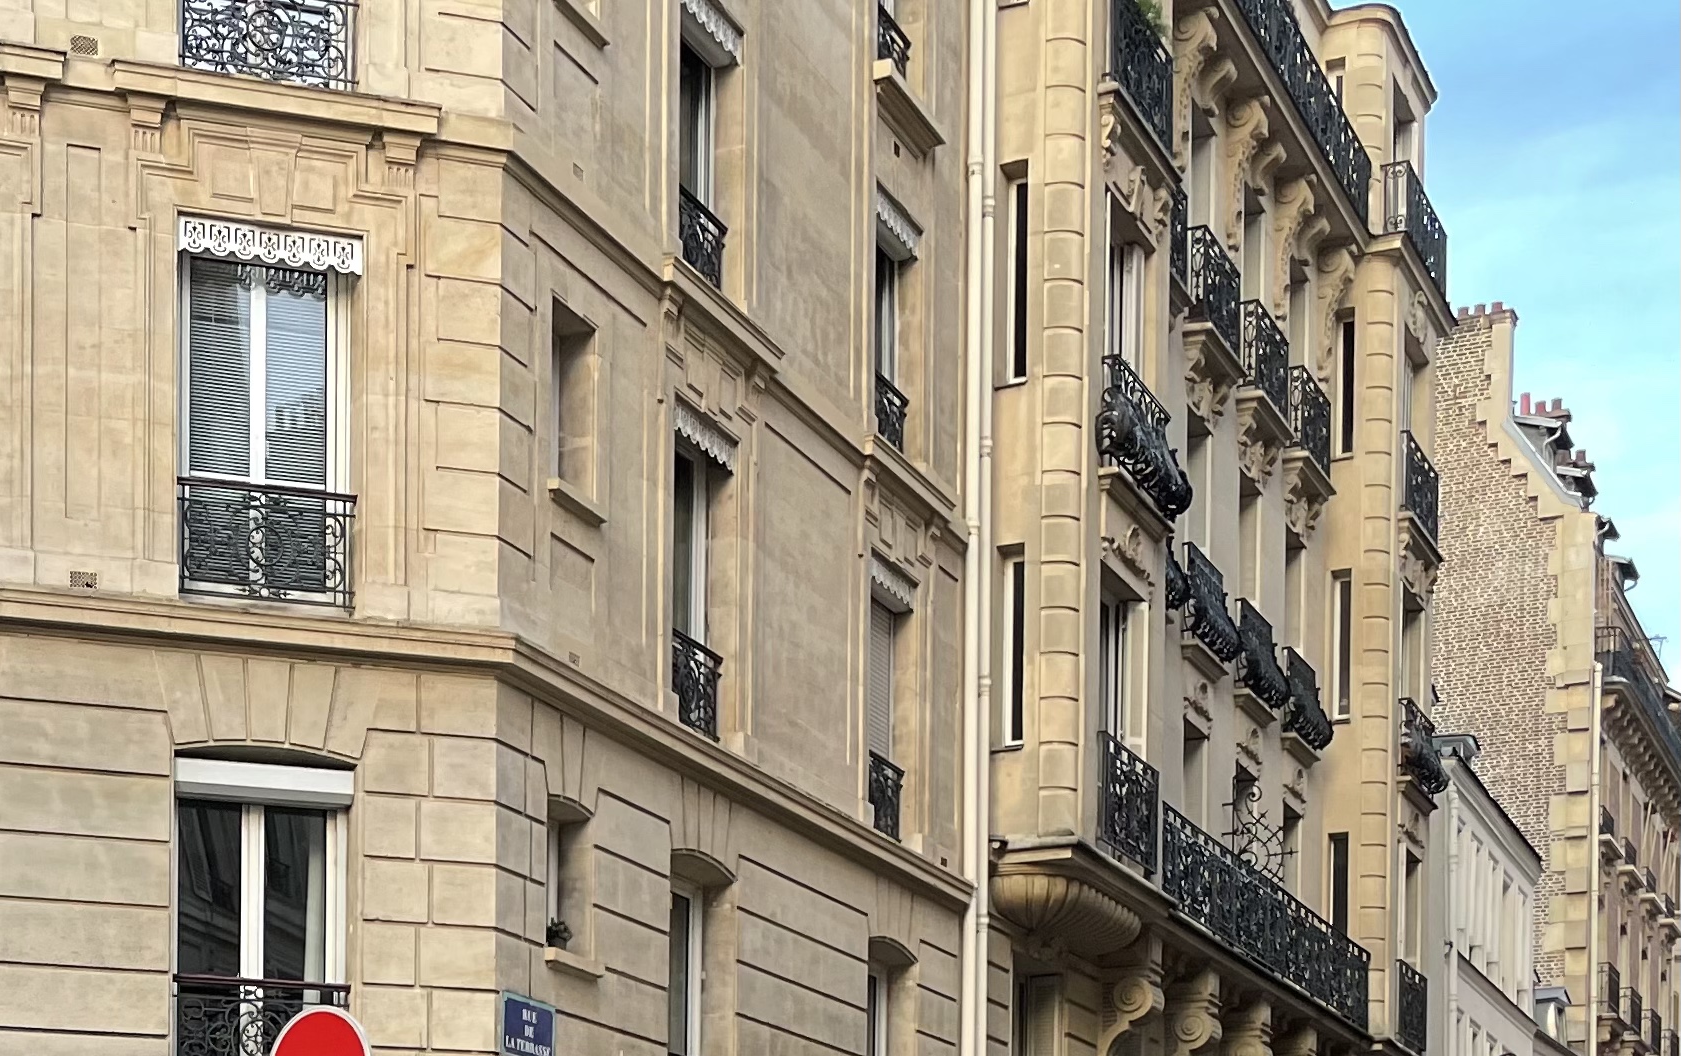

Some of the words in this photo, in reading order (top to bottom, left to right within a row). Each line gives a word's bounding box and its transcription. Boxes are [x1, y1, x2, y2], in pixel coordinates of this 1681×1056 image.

[522, 1008, 538, 1024] RUE
[524, 1024, 535, 1039] DE
[505, 1034, 516, 1049] LA
